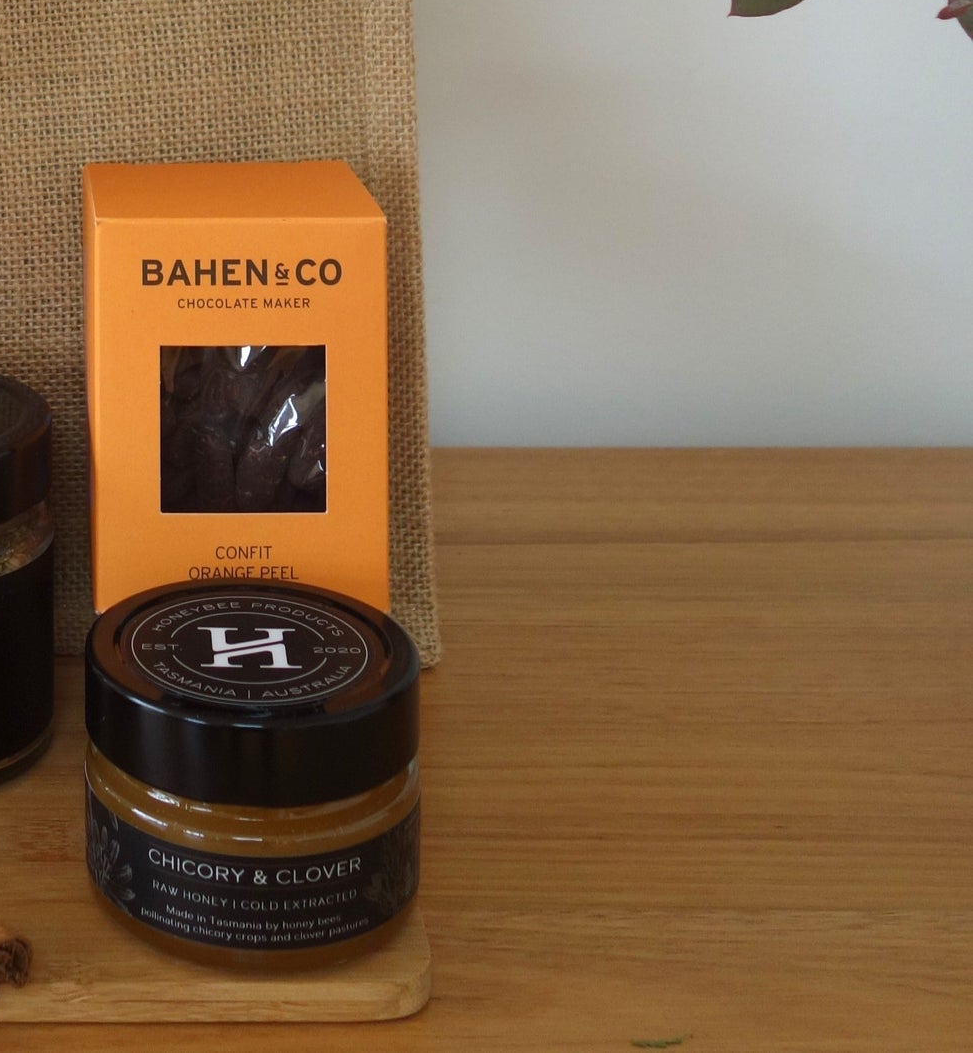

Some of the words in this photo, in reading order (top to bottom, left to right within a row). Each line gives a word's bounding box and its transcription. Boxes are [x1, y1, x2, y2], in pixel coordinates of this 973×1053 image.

[177, 298, 258, 309] CHOCOLATE
[263, 298, 311, 309] MAKER
[215, 545, 273, 560] CONFIT
[188, 566, 255, 580] ORANGE
[260, 566, 299, 580] PEEL
[152, 602, 242, 632] HONEYBEE
[251, 602, 345, 637] PRODUCTS
[313, 646, 362, 654] 2020
[153, 661, 237, 697] TASMANIA
[262, 666, 352, 698] AUSTRALIA
[148, 848, 245, 884] CHICORY
[253, 870, 268, 885] &
[276, 857, 361, 885] CLOVER
[152, 879, 179, 897] RAW
[240, 900, 279, 911] COLD
[284, 889, 357, 911] EXTRACTED
[140, 907, 190, 934] pollinating
[192, 925, 233, 942] chicory
[235, 932, 267, 944] crops
[270, 932, 291, 943] and
[294, 930, 326, 940] clover
[329, 918, 370, 938] pastures
[166, 904, 194, 920] Made
[197, 913, 207, 923] in
[211, 915, 262, 930] Tasmania
[265, 921, 279, 931] by
[283, 919, 315, 929] honey
[317, 915, 341, 926] bees
